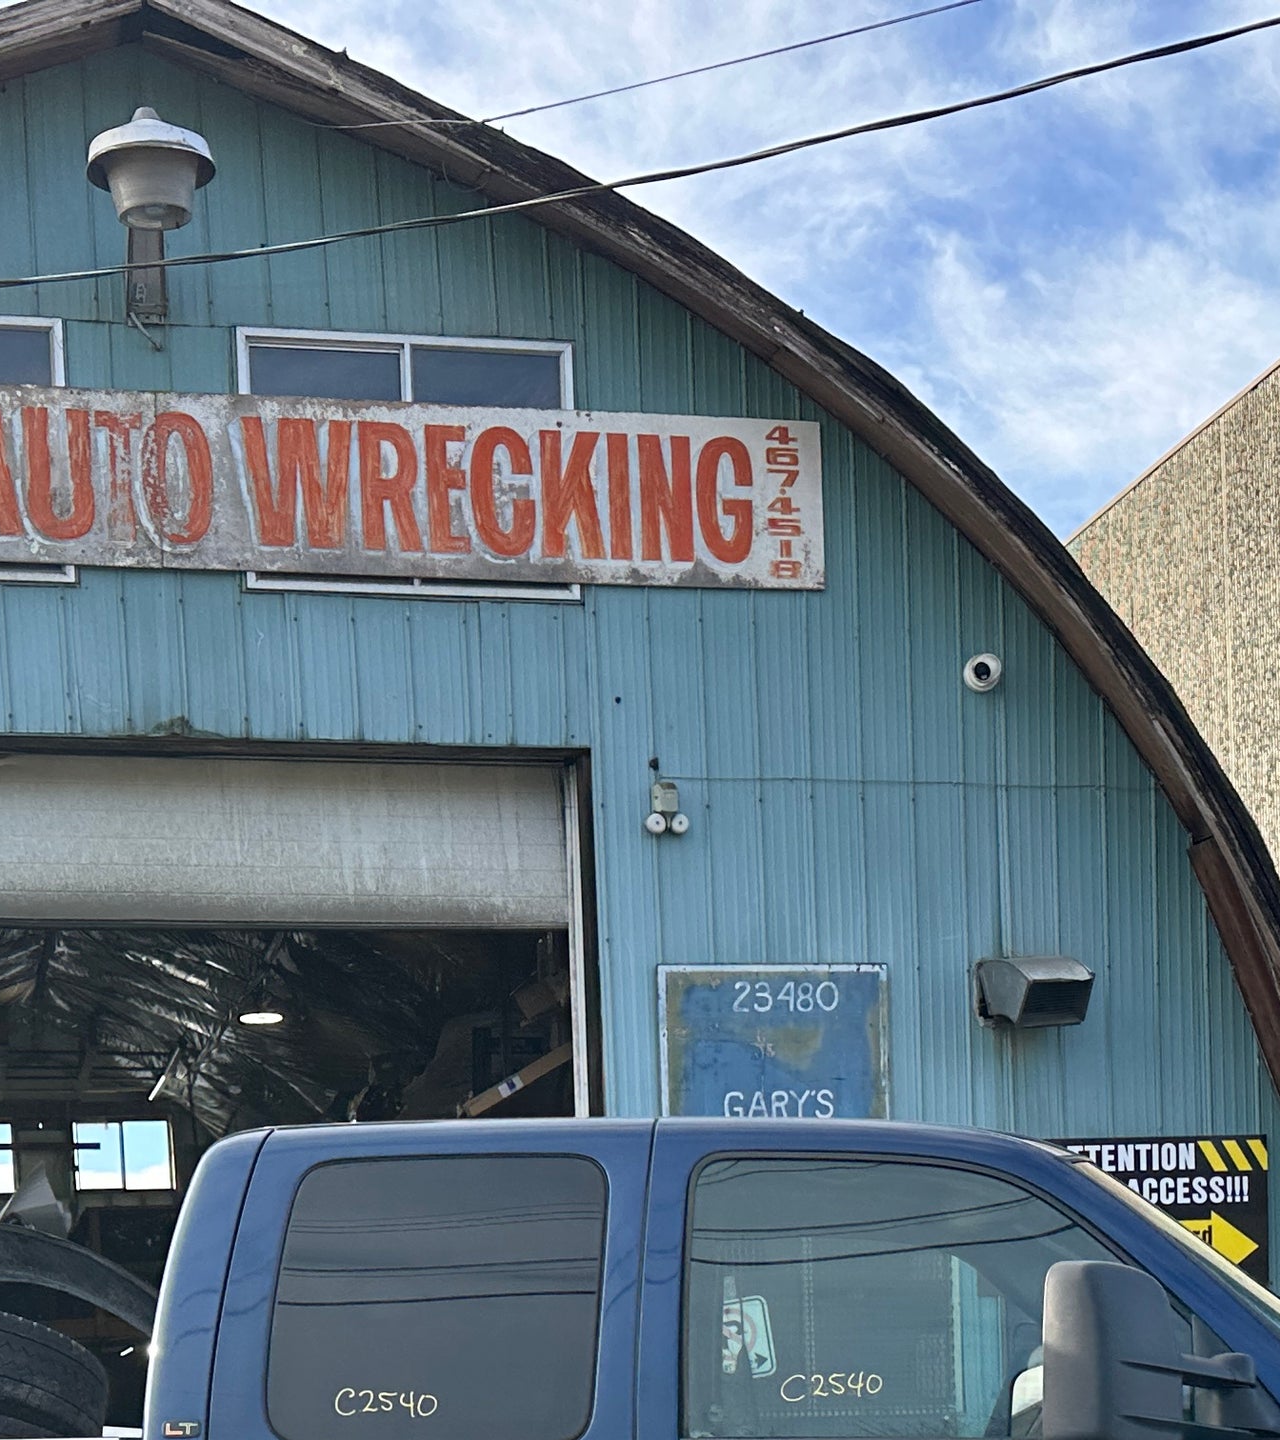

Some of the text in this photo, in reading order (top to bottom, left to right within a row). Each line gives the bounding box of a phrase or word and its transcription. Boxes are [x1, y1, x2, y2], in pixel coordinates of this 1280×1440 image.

[240, 414, 755, 565] WRECKING
[732, 980, 839, 1013] 23480
[723, 1089, 834, 1118] GARY'S
[780, 1371, 884, 1402] C2540
[334, 1387, 438, 1418] C2540
[165, 1422, 199, 1436] LT
